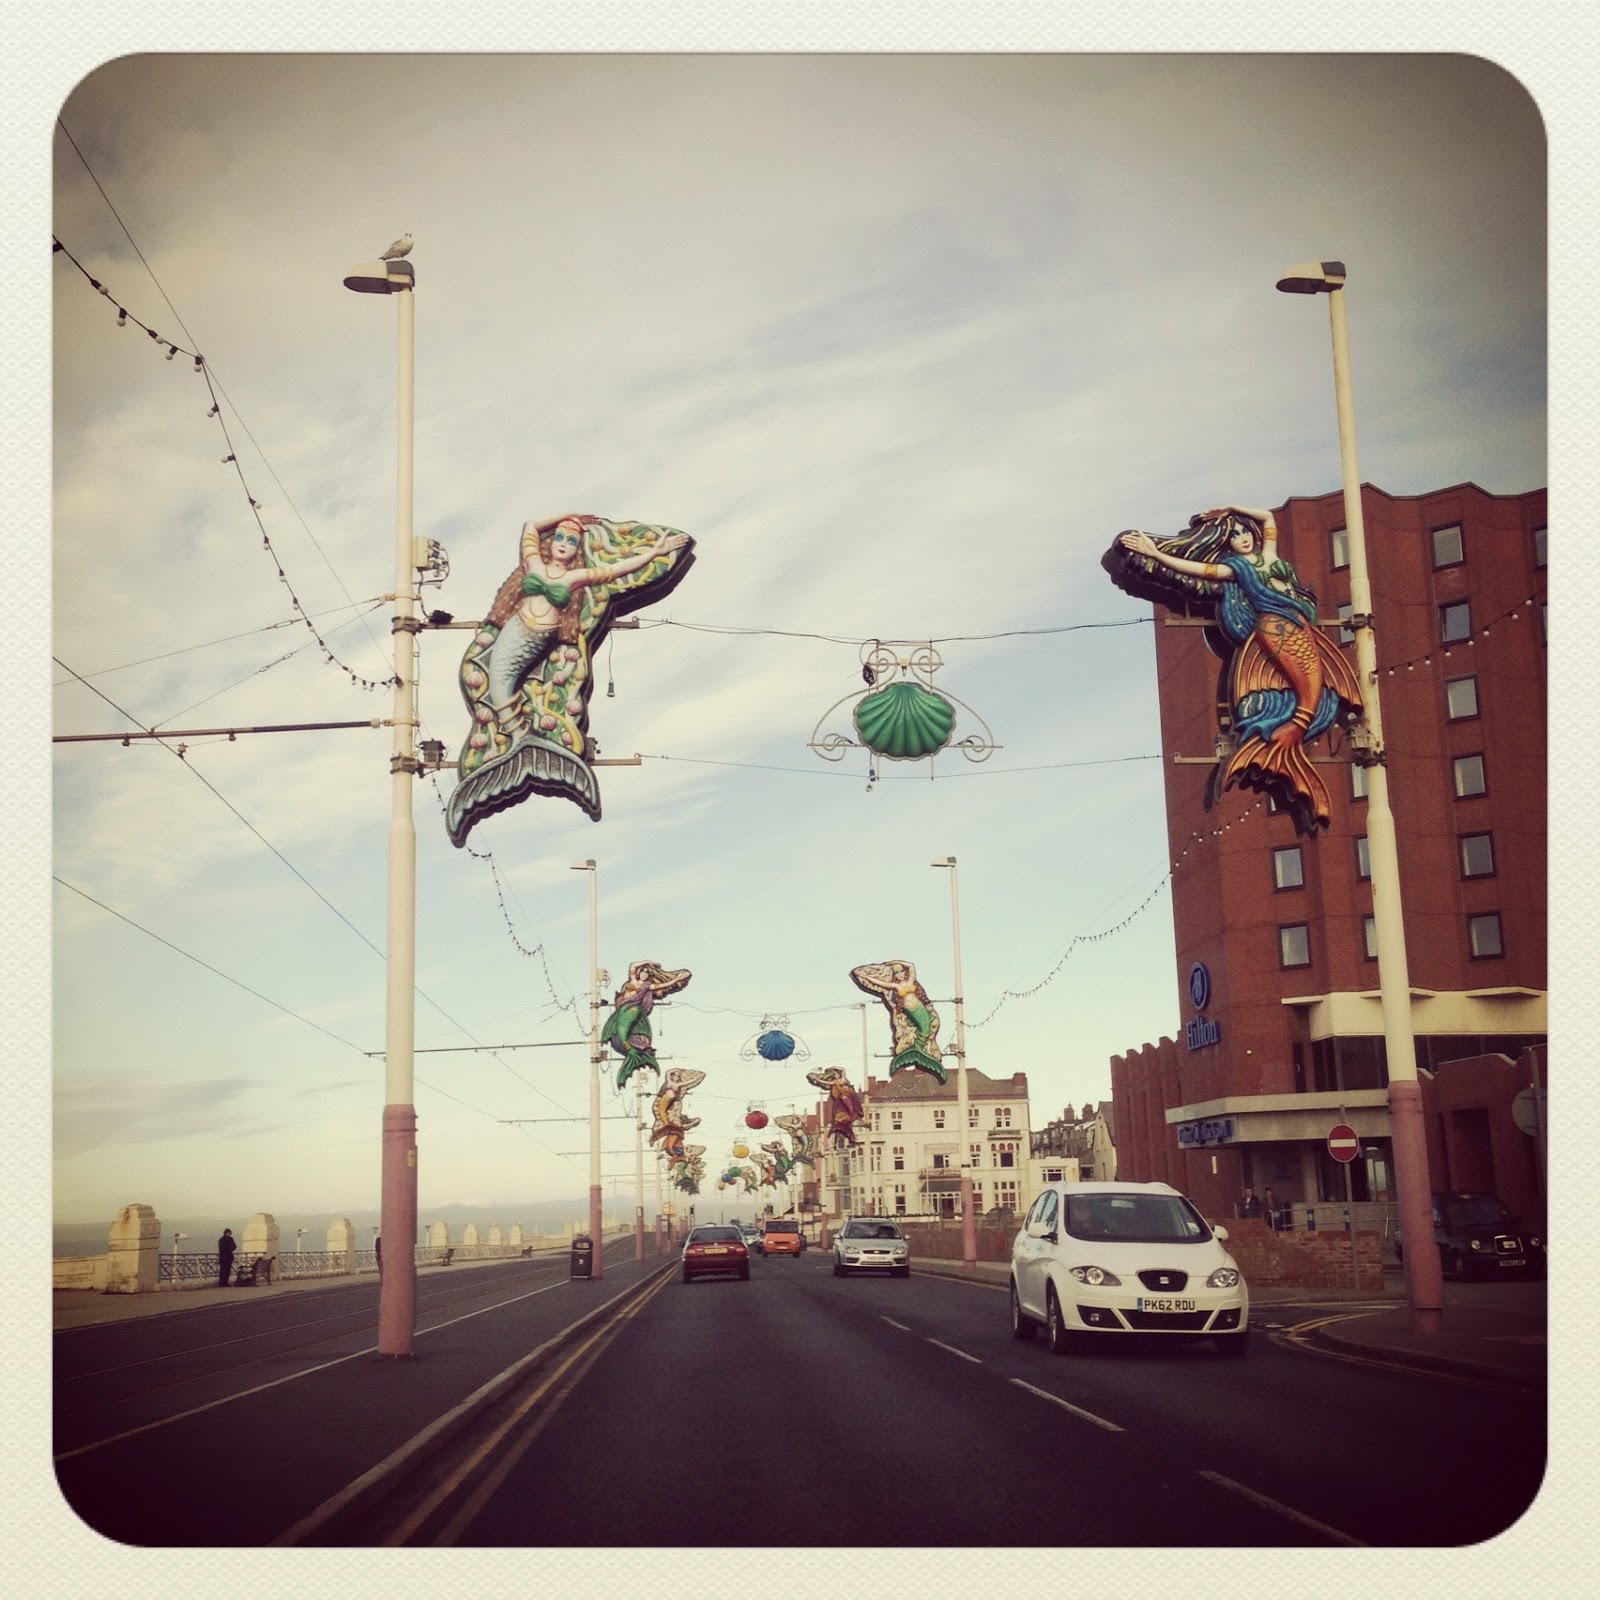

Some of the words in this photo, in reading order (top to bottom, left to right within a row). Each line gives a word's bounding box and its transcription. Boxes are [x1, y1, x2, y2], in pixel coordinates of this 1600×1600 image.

[1186, 1016, 1219, 1050] Hilton
[1144, 1300, 1172, 1311] PK62
[1175, 1300, 1196, 1311] RDU
